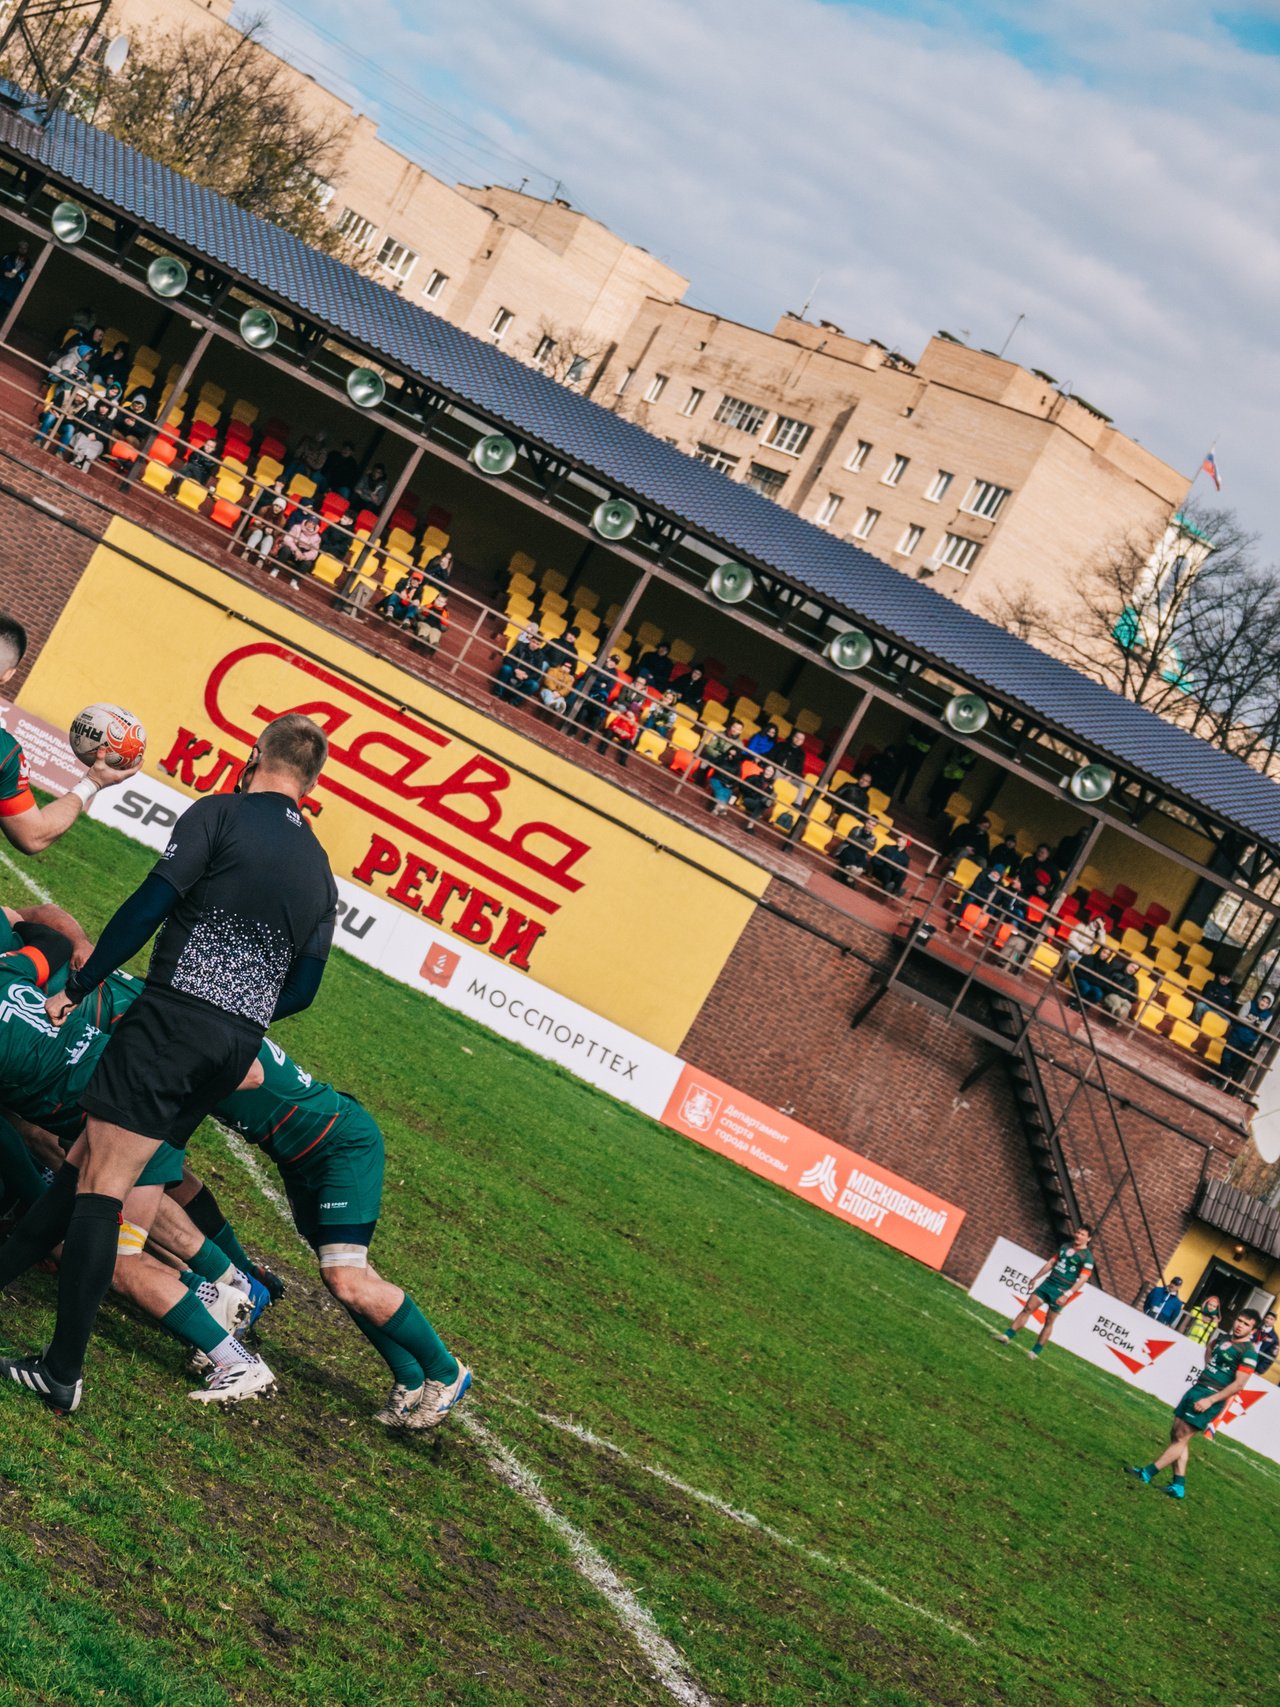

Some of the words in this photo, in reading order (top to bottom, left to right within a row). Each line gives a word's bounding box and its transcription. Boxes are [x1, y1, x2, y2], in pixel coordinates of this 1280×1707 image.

[14, 727, 78, 763] ЭКИПИРОВЩИК
[18, 719, 73, 754] ОФИЦИАЛЬНЫ
[50, 756, 85, 779] РОССИИ
[352, 833, 547, 971] РЕГБИ
[467, 977, 639, 1081] МОССПОРТТЕХ
[719, 1117, 754, 1140] спорта
[723, 1104, 790, 1144] Департамент
[714, 1128, 749, 1154] города
[749, 1144, 789, 1173] Москвы
[837, 1189, 889, 1228] СПОРТ
[846, 1169, 948, 1236] МОСКОВСКИЙ
[999, 1275, 1032, 1296] РОСС
[1092, 1325, 1135, 1352] РОССИИ
[1097, 1315, 1130, 1338] РЕГБИ
